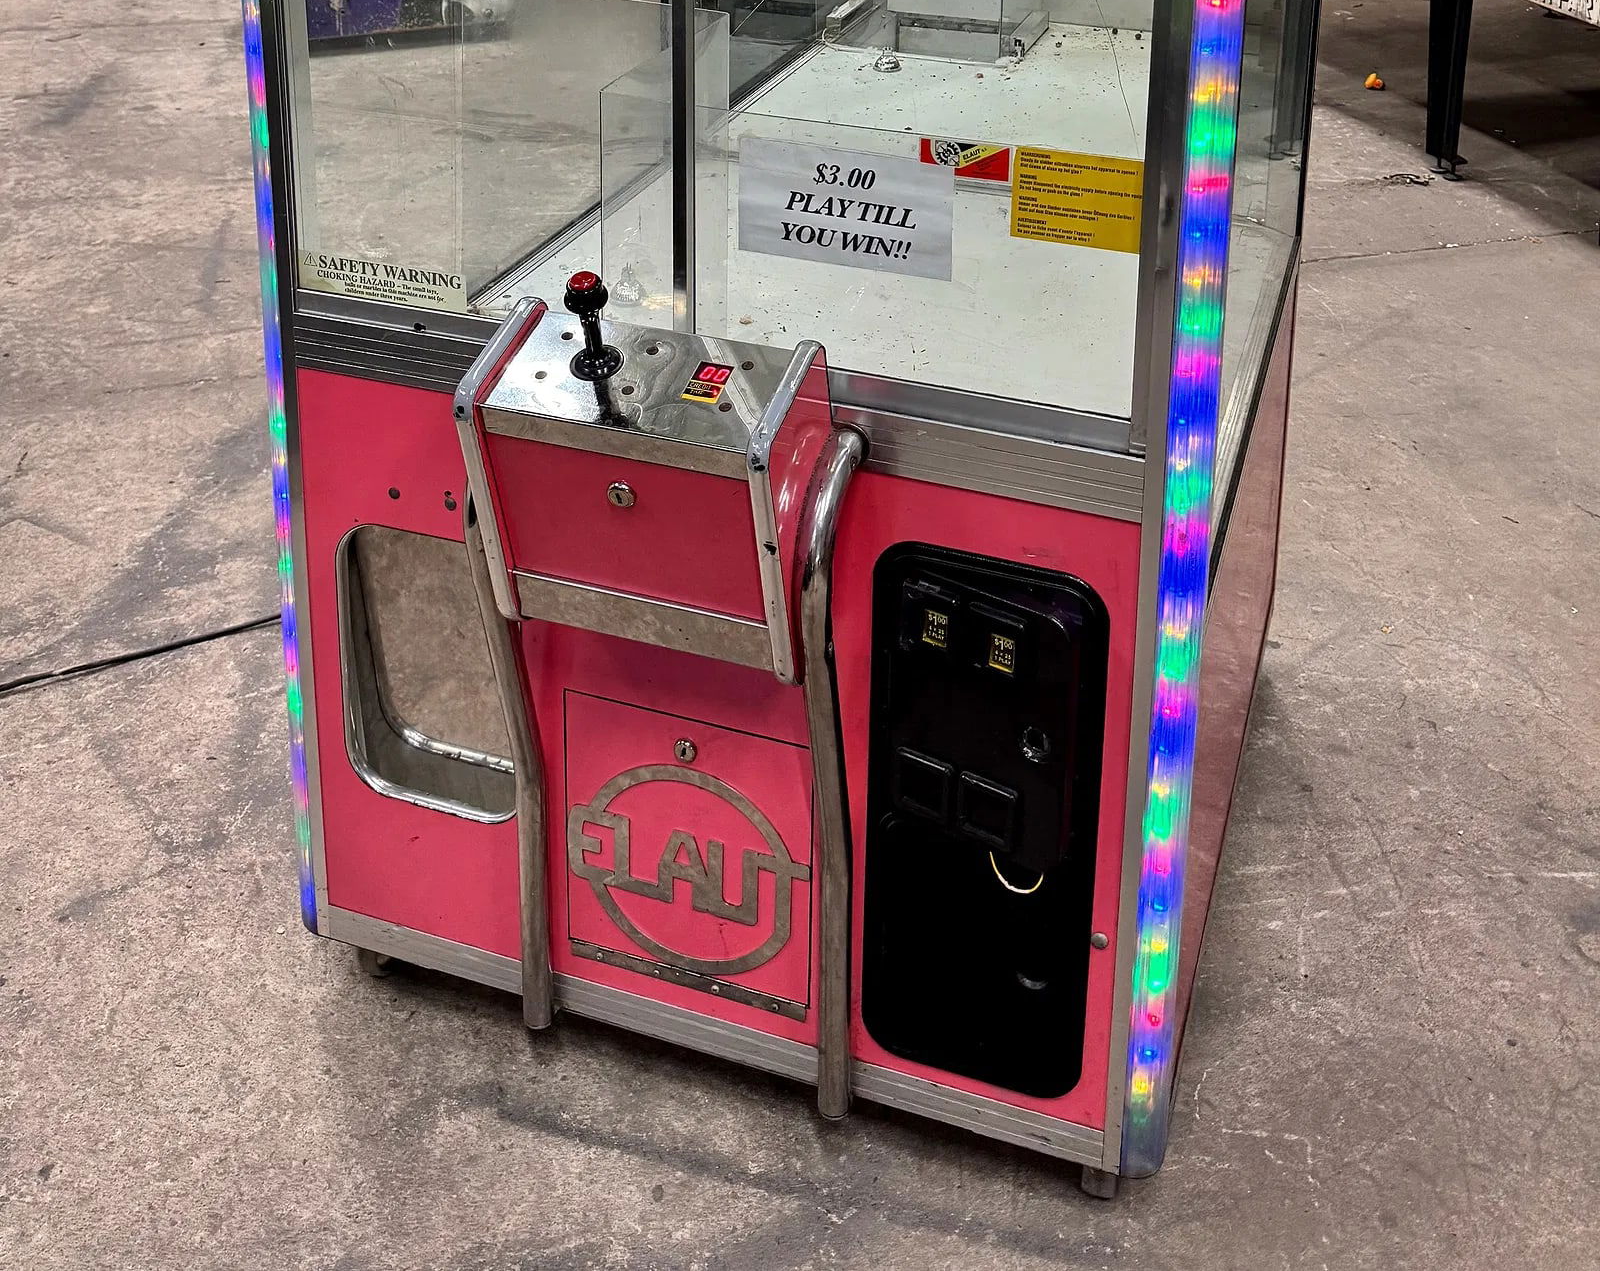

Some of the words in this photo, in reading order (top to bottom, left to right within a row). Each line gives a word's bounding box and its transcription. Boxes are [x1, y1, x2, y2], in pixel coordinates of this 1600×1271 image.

[962, 148, 981, 160] ELAUT
[813, 162, 876, 190] $3.00
[784, 191, 856, 221] PLAY
[858, 201, 916, 230] TILL
[781, 222, 838, 247] YOU
[840, 230, 912, 260] WIN!!
[317, 269, 358, 283] CHOKING
[360, 276, 396, 289] HAZARD
[319, 254, 380, 277] SAFETY
[383, 264, 462, 290] WARNING
[699, 366, 731, 382] 00
[567, 803, 811, 927] ELAUT
